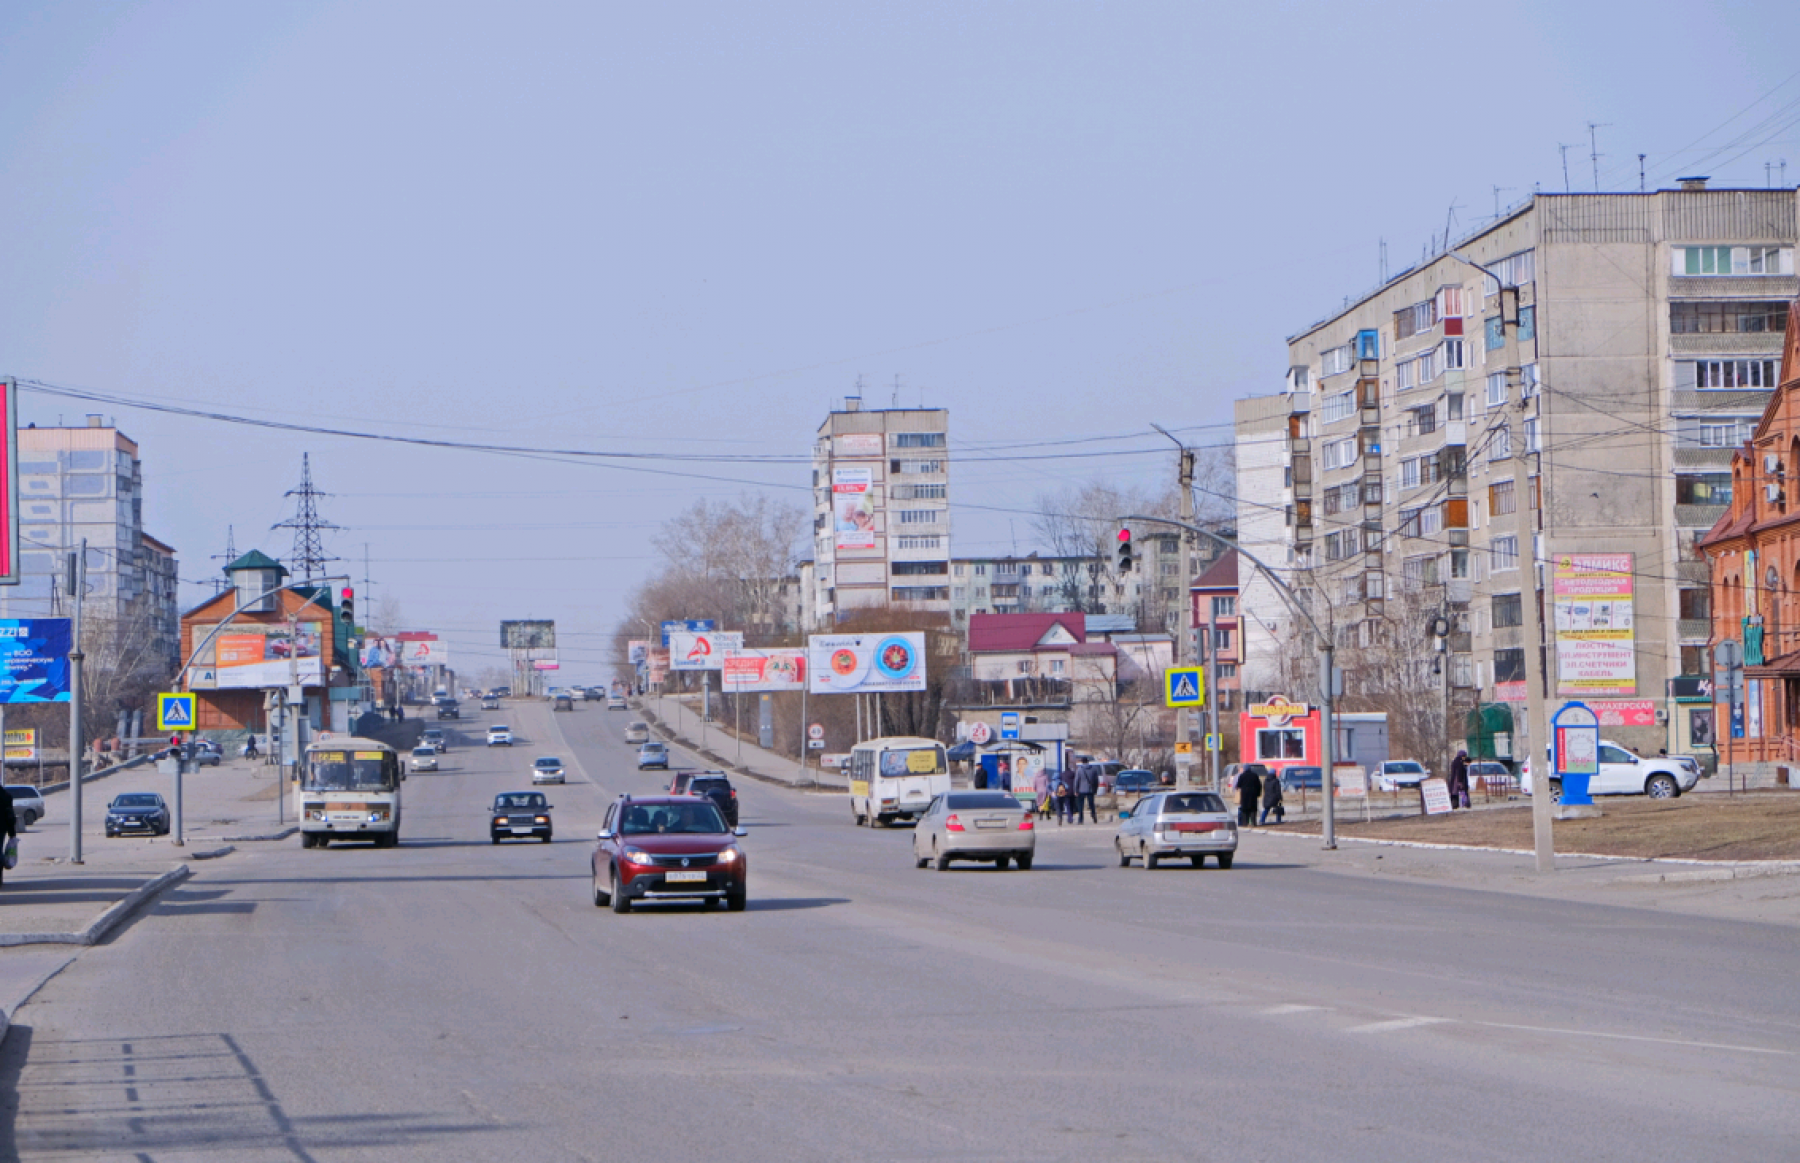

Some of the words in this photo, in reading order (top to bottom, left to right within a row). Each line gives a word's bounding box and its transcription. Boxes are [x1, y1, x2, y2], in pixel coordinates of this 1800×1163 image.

[1572, 559, 1630, 571] ЭЛМИКС
[1558, 578, 1628, 586] СВЕТОДИОДНАЯ
[1567, 586, 1619, 594] ПРОДУКЦИЯ
[1575, 642, 1616, 650] ЛЮСТРЫ
[1251, 705, 1305, 716] ШАВЕРМА
